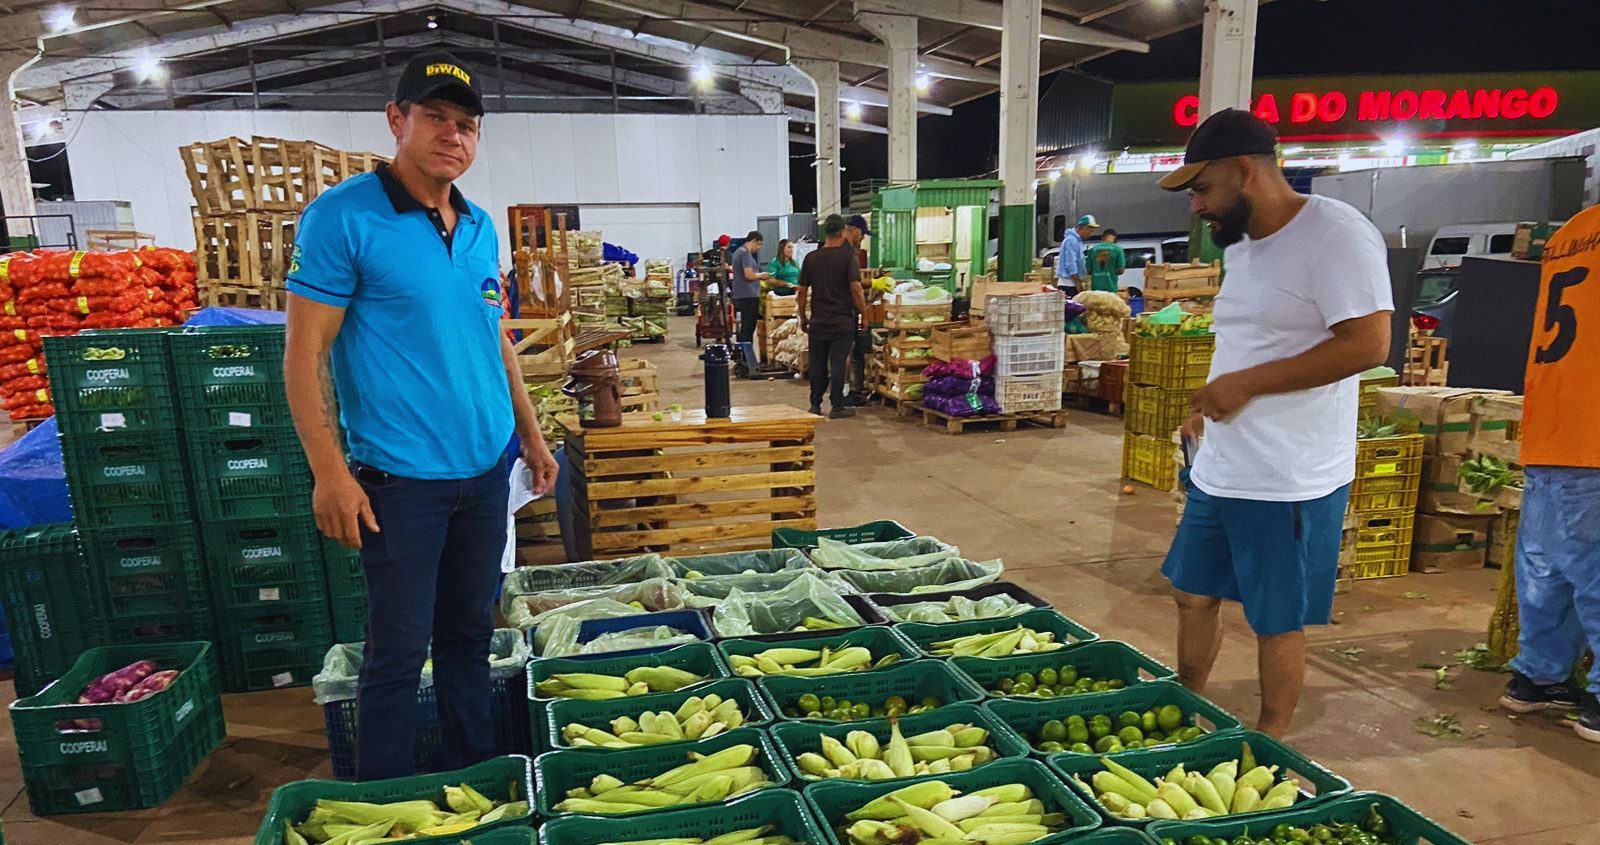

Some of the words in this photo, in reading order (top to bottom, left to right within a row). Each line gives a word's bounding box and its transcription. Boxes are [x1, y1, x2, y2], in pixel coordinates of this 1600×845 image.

[1173, 94, 1280, 127] CA
[1290, 91, 1347, 123] DO
[1358, 87, 1559, 121] MORANGO
[1535, 266, 1590, 364] 5
[86, 367, 130, 380] COOPERAI
[212, 366, 255, 378] COOPERAI
[104, 464, 146, 477] COOPERAI
[227, 458, 268, 470] COOPERAI
[242, 545, 282, 559] COOPERAI
[120, 554, 162, 568] COOPERAI
[254, 632, 295, 644] COOPERAI
[60, 739, 107, 754] COOPERAI
